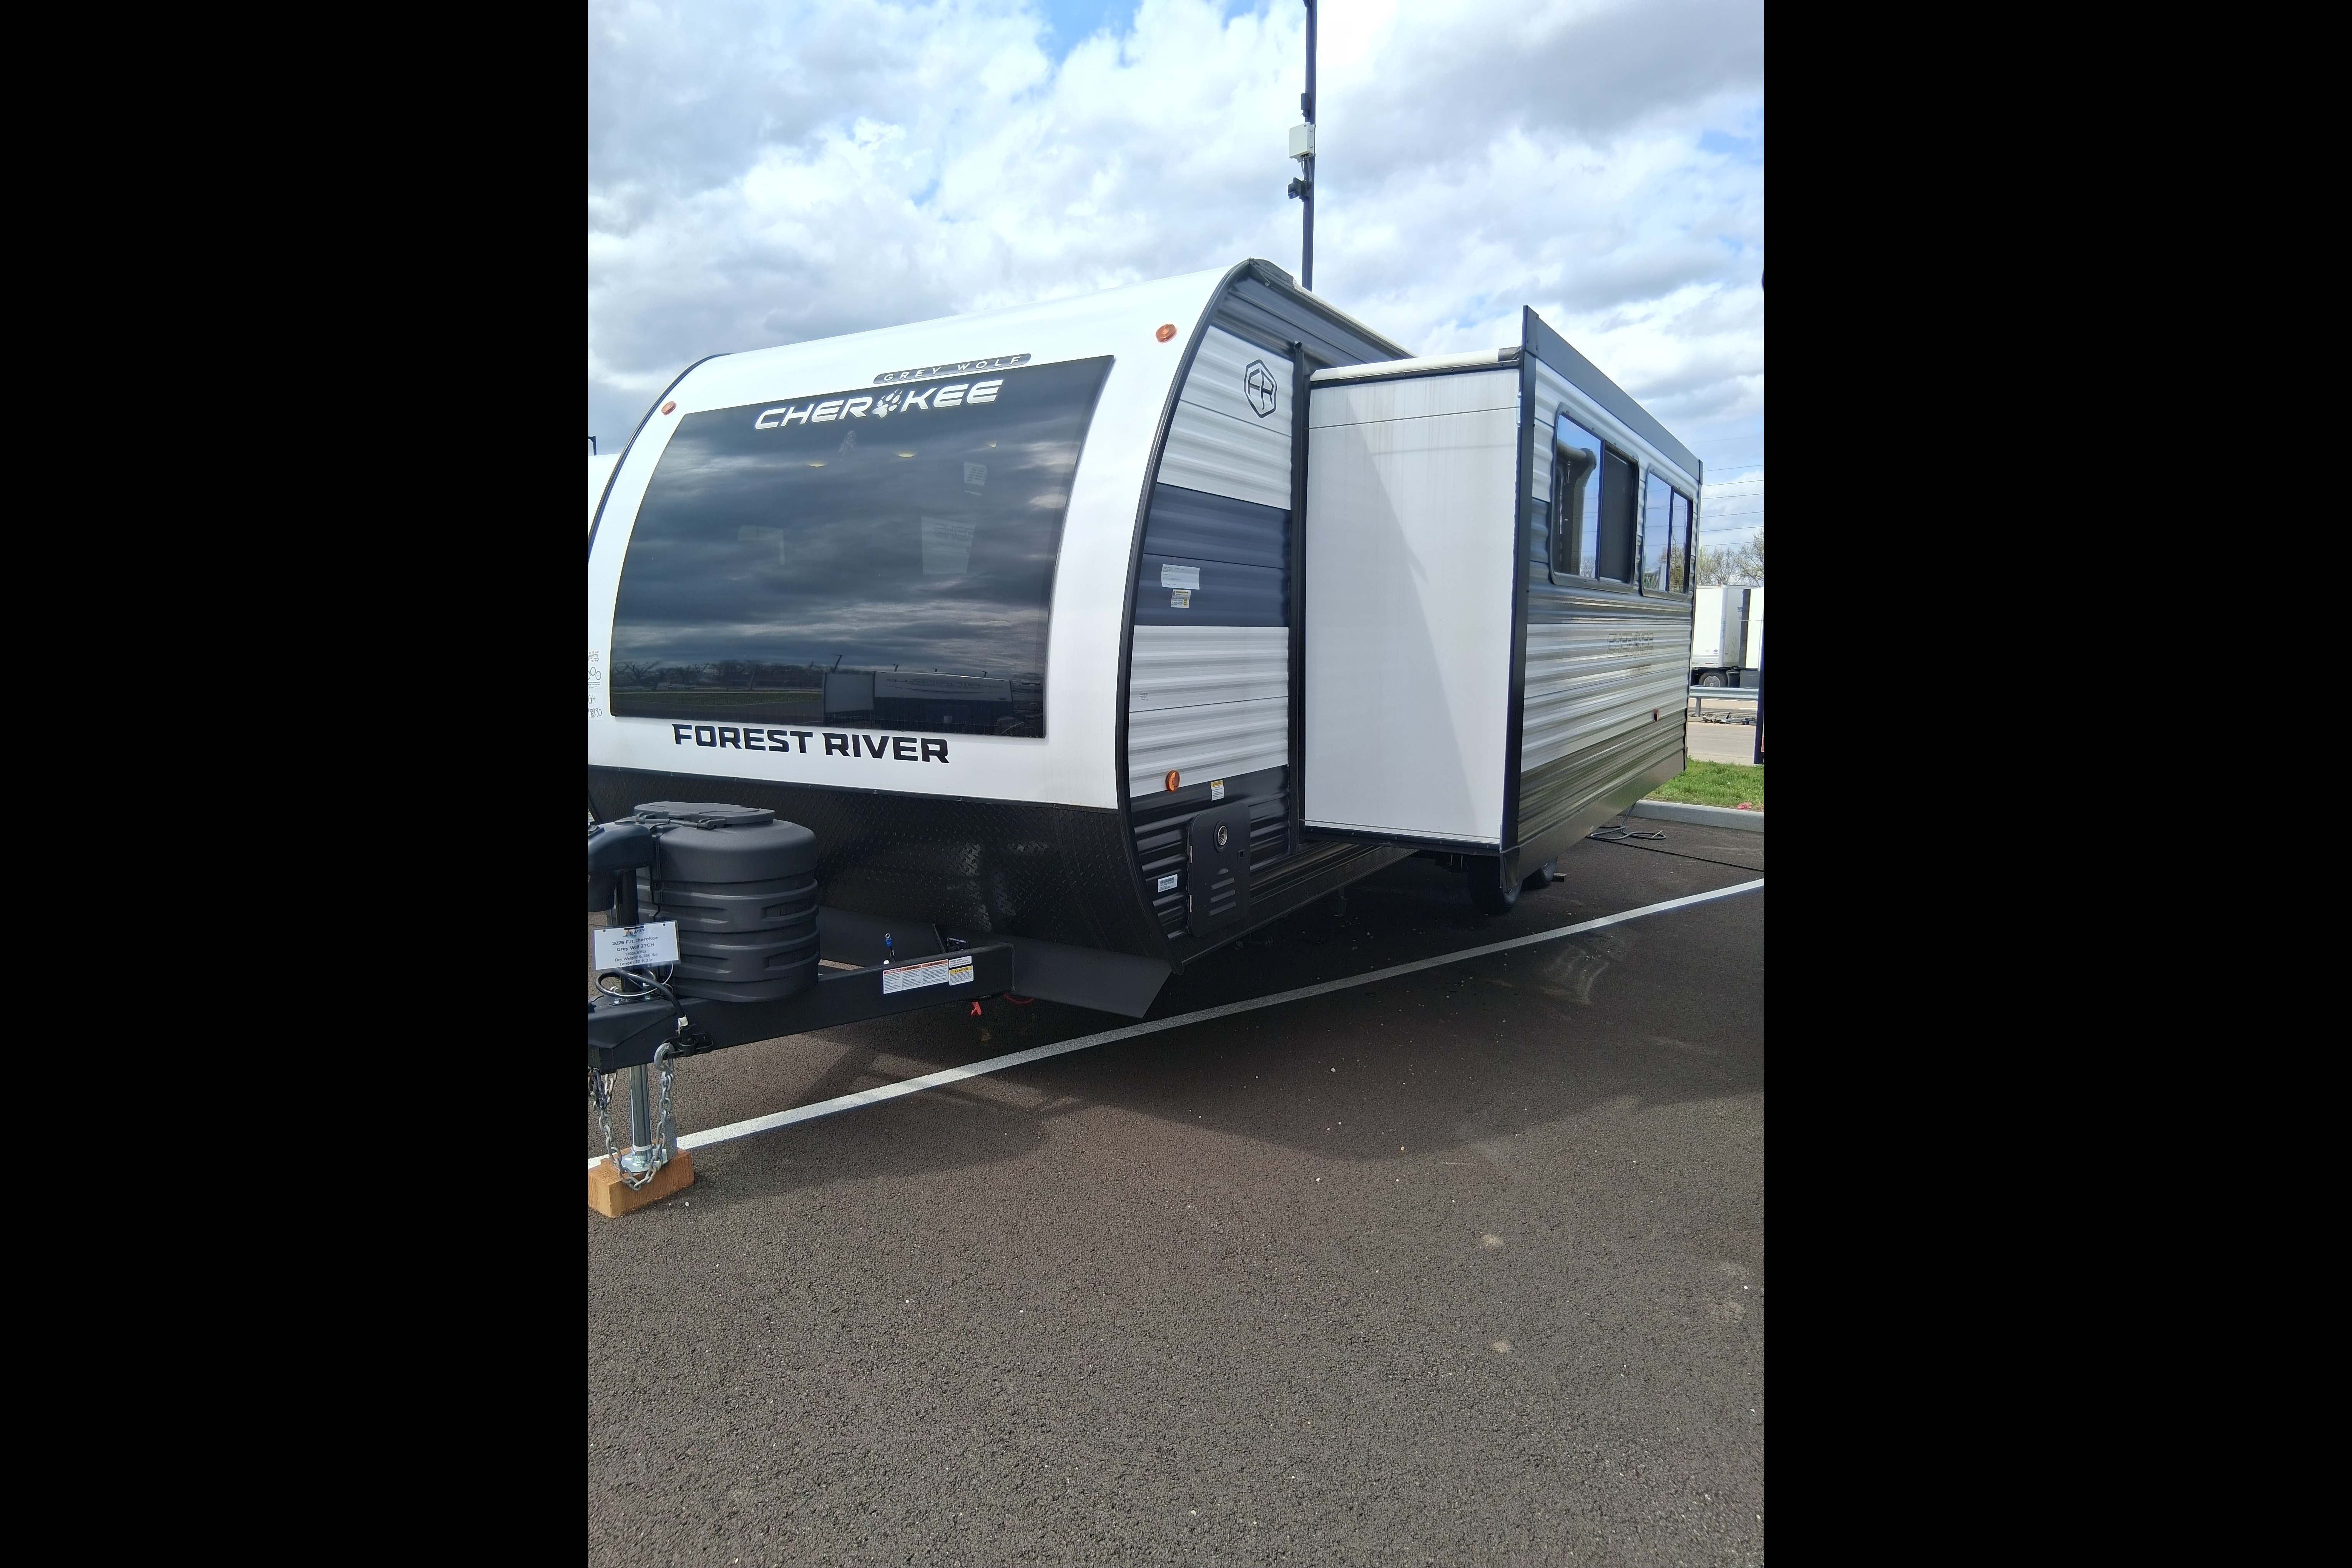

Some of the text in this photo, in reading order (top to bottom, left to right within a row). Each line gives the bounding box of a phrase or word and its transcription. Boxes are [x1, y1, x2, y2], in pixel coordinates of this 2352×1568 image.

[883, 356, 1022, 382] GREY WOLF
[671, 724, 950, 764] FOREST RIVER
